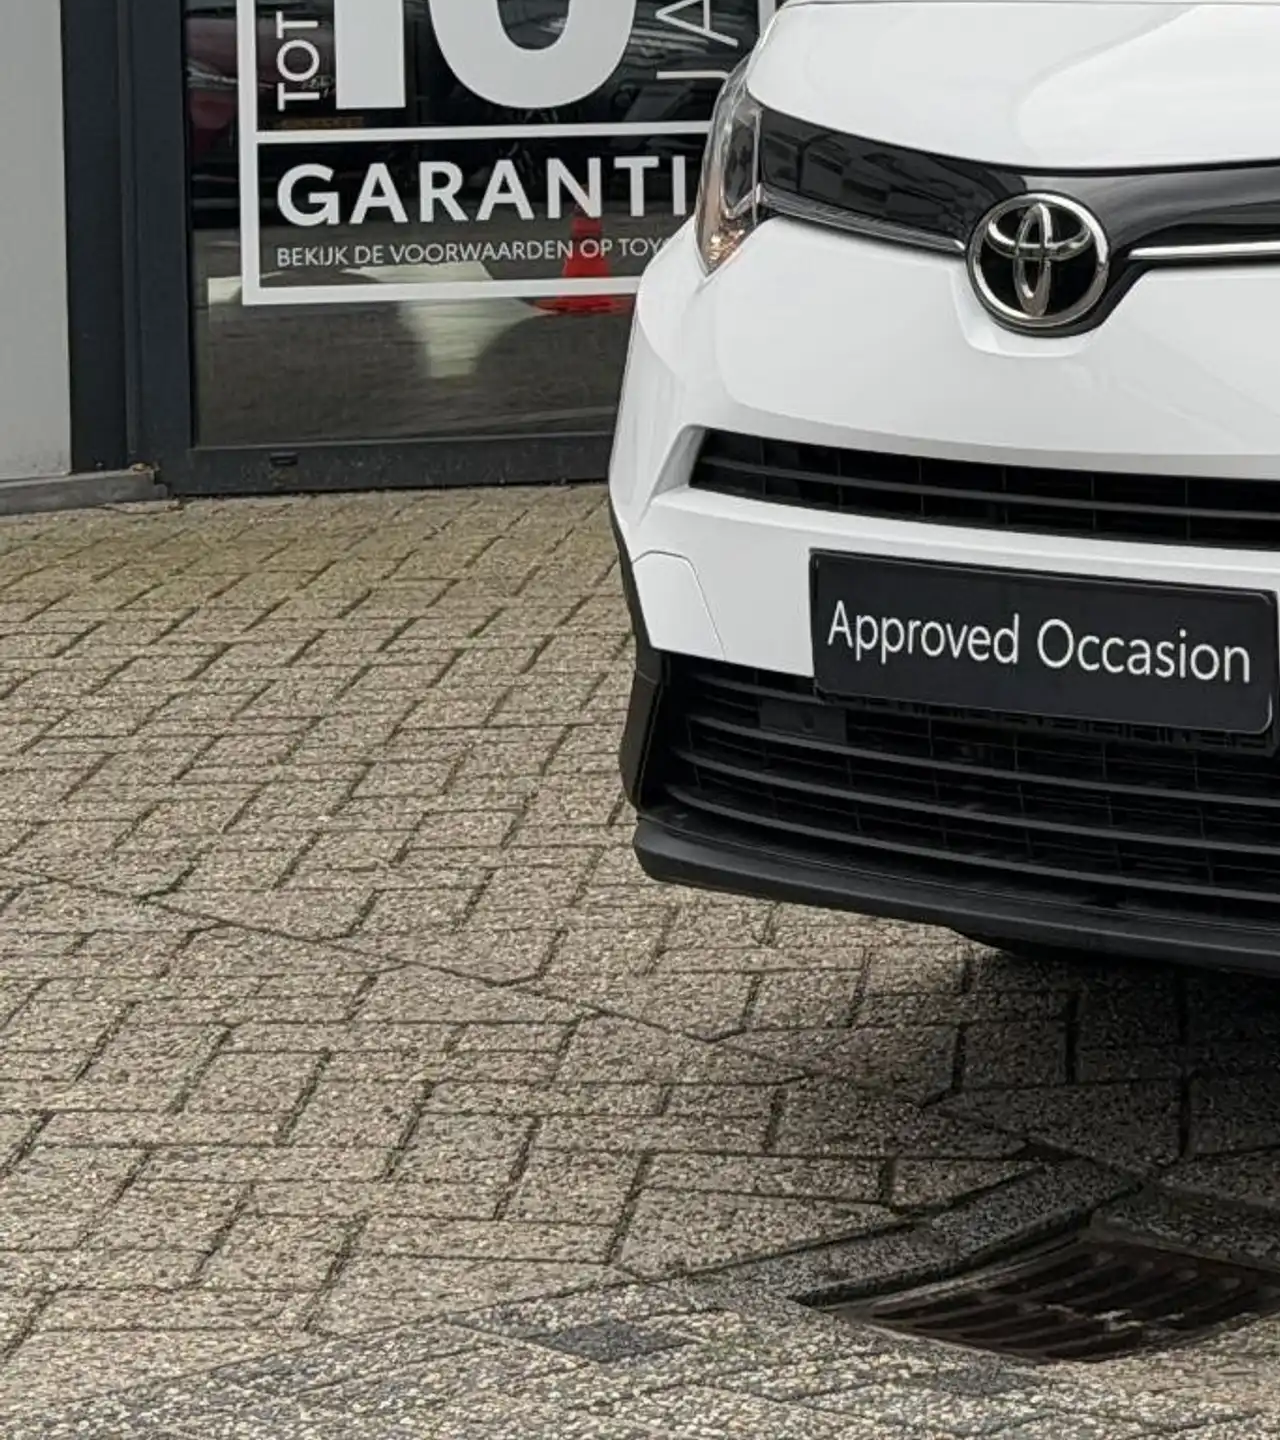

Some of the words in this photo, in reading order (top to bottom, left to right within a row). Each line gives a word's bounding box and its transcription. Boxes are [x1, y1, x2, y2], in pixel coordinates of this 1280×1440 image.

[276, 10, 320, 111] TOT
[276, 155, 686, 227] GARANTI
[277, 246, 349, 267] BEKIJK
[355, 244, 384, 264] DE
[389, 239, 574, 264] VOORWAARDEN
[580, 239, 612, 258] OP
[618, 238, 670, 257] TOY
[827, 600, 1020, 664] Approved
[1036, 618, 1251, 684] Occasion
